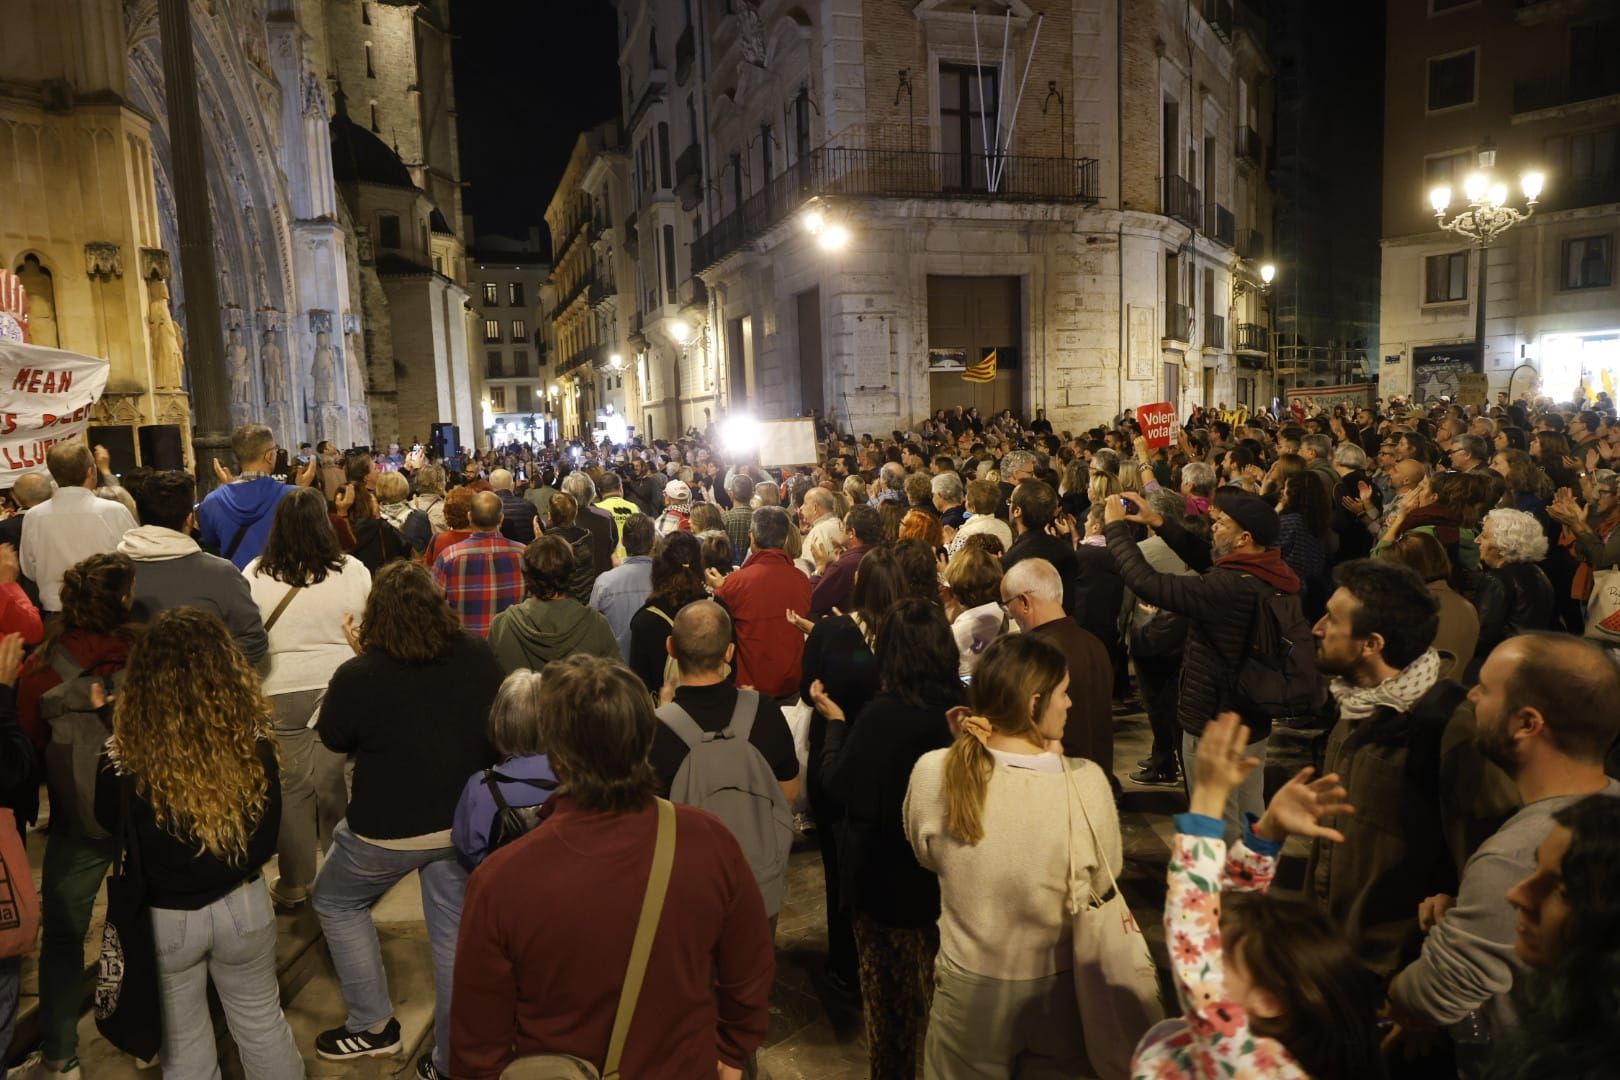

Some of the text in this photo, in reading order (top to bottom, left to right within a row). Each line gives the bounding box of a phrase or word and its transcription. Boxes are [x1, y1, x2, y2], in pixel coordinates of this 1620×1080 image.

[12, 368, 73, 393] MEAN
[0, 413, 17, 435] S
[1143, 411, 1176, 426] Volem
